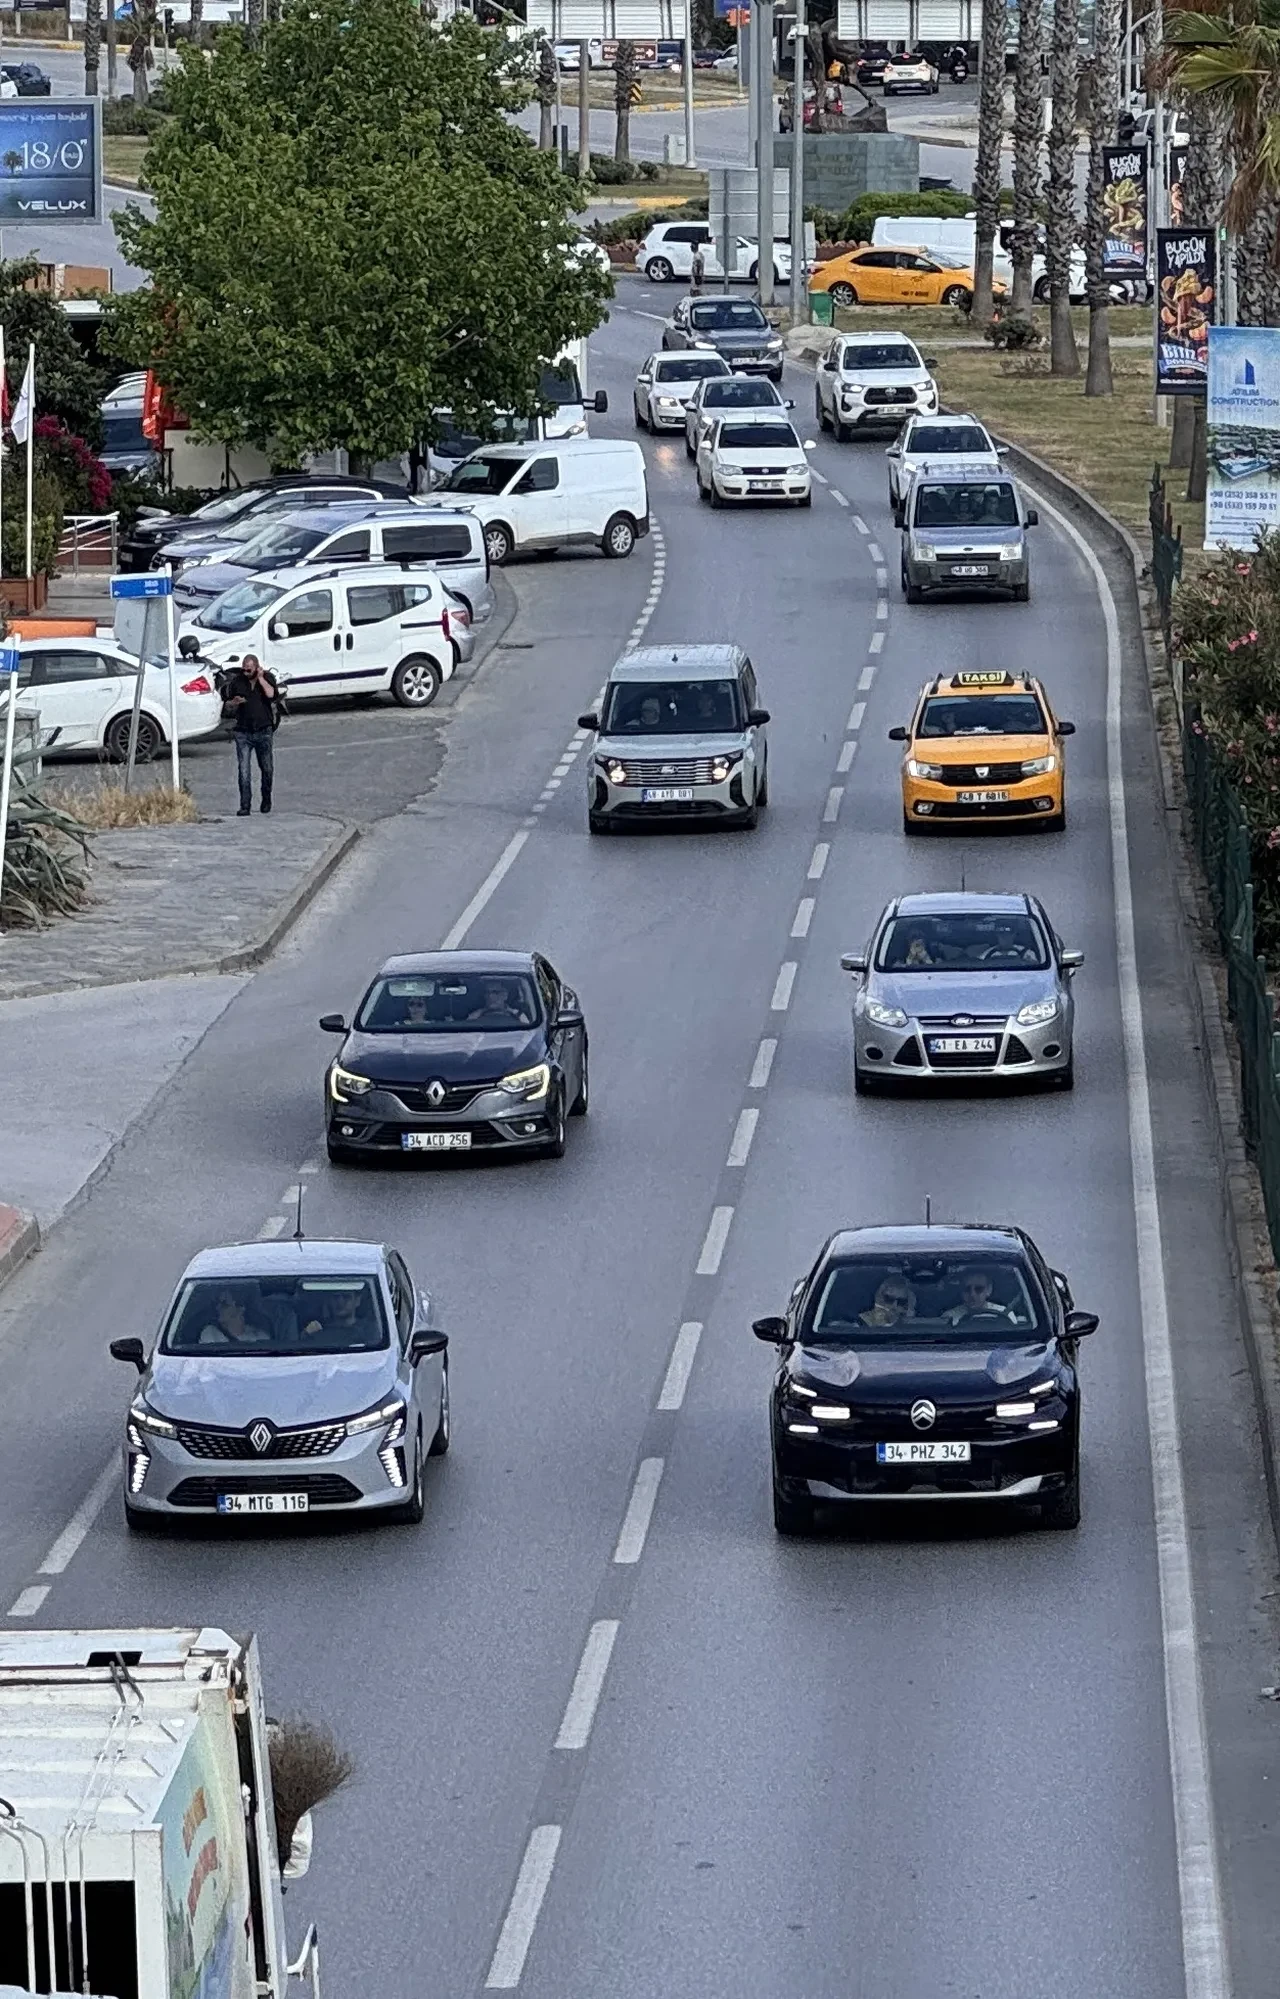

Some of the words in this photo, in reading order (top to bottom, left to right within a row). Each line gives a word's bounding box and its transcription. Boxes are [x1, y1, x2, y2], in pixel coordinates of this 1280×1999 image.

[17, 200, 87, 210] VELUX
[1211, 396, 1279, 406] CONSTRUCTION
[977, 792, 982, 801] T
[936, 1040, 947, 1050] 41
[954, 1039, 968, 1050] EA
[974, 1039, 993, 1050] 244
[409, 1135, 421, 1146] 34
[426, 1135, 445, 1146] ACD
[449, 1134, 468, 1146] 256
[887, 1445, 903, 1460] 34
[911, 1445, 936, 1459] PHZ
[942, 1444, 966, 1459] 342
[226, 1497, 242, 1511] 34
[249, 1496, 273, 1511] MTG
[282, 1495, 306, 1510] 116
